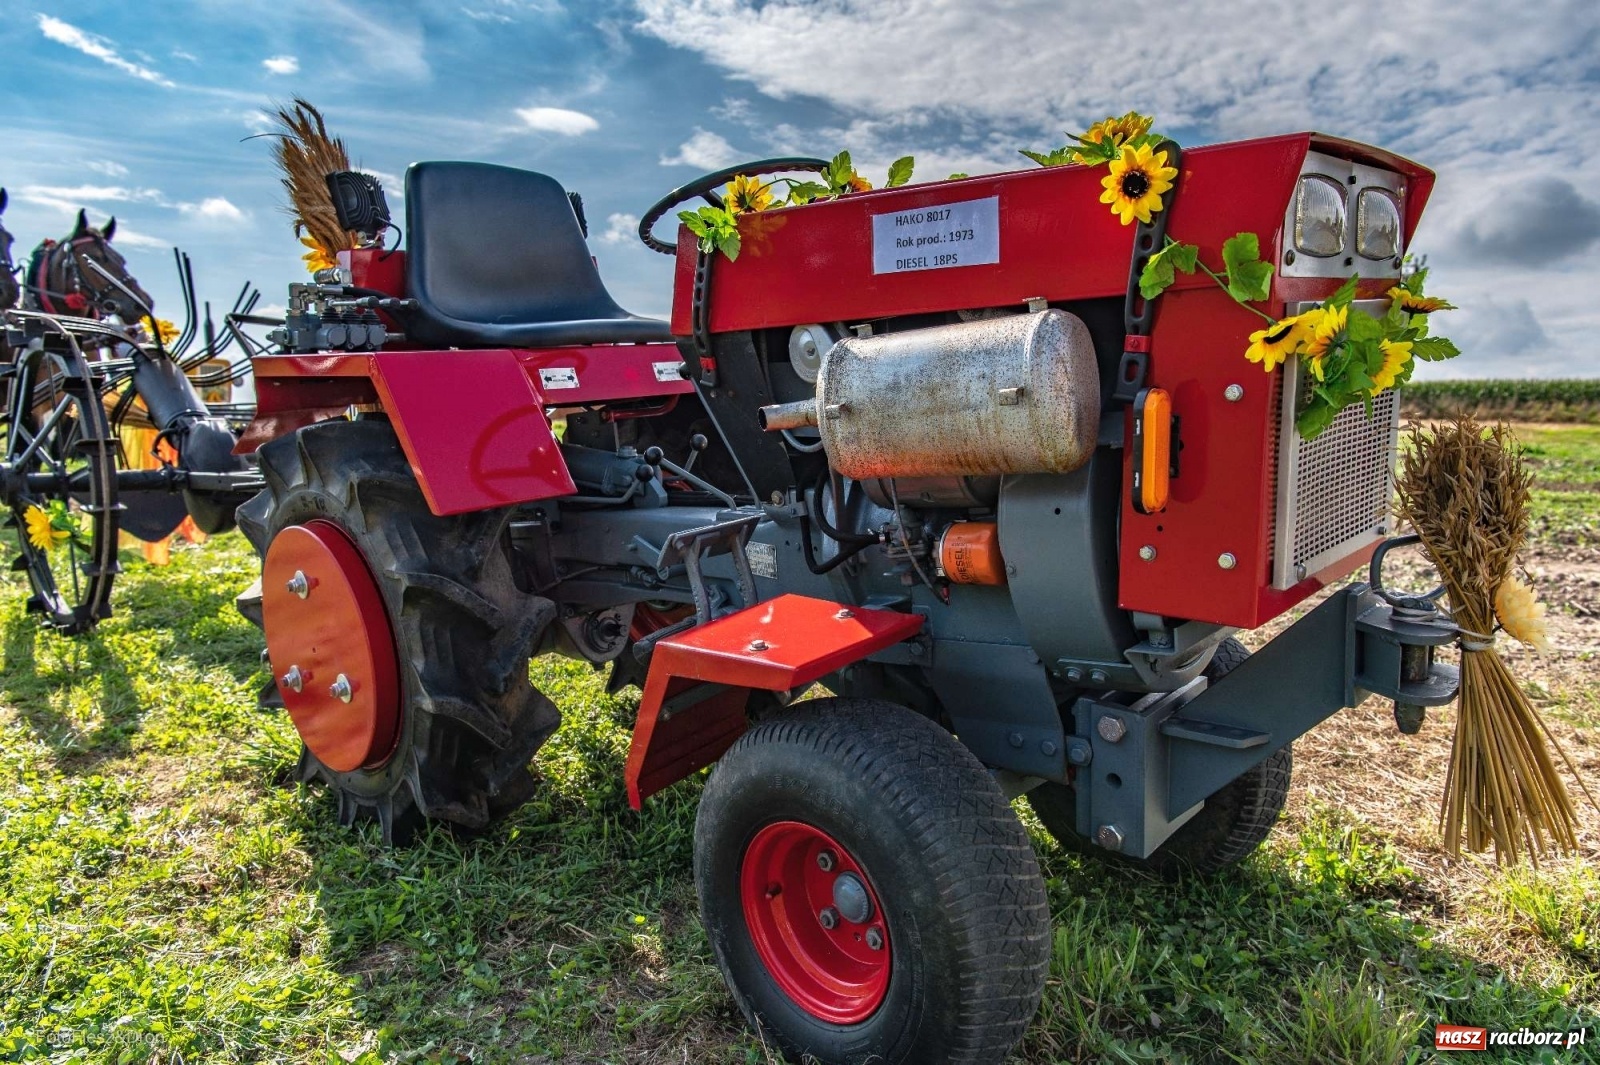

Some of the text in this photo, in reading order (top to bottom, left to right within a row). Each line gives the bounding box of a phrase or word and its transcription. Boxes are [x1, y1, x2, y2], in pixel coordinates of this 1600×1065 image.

[895, 209, 951, 226] HAKO 8017
[896, 229, 974, 248] Rok prod.: 1973
[896, 253, 958, 270] DIESEL 18PS
[954, 547, 970, 581] DIESEL
